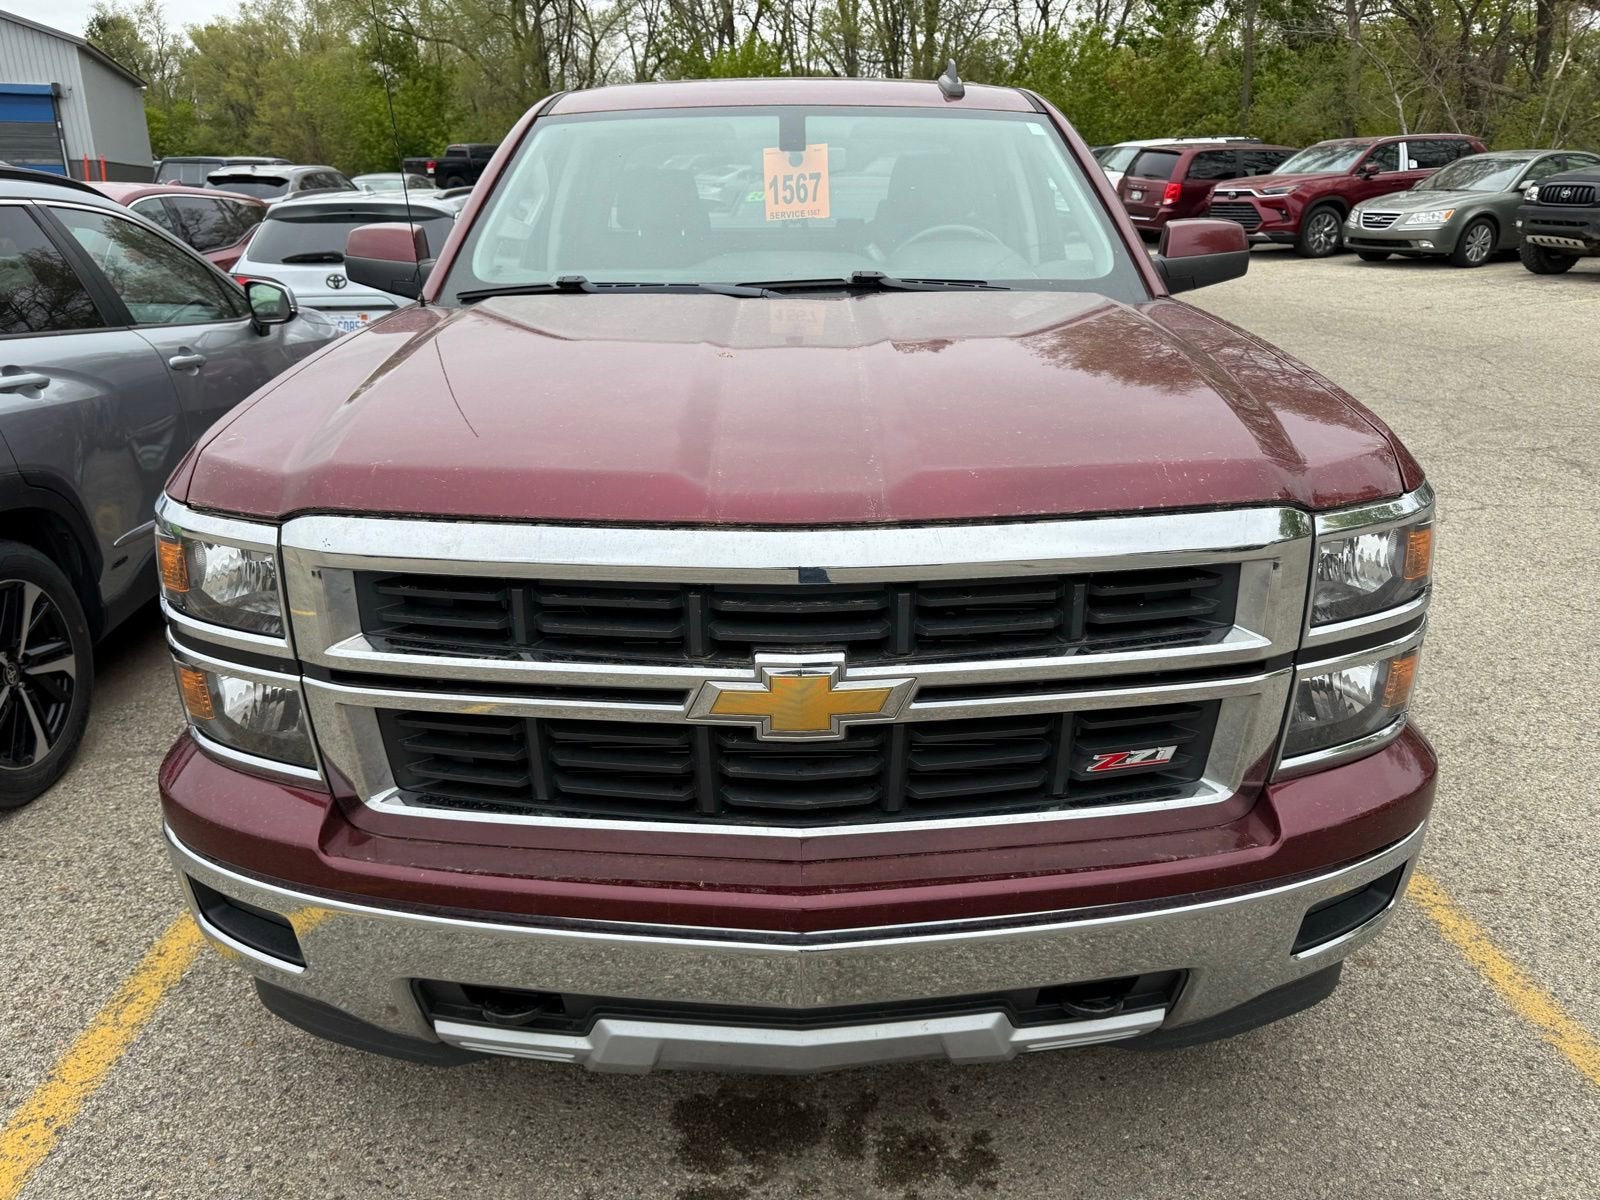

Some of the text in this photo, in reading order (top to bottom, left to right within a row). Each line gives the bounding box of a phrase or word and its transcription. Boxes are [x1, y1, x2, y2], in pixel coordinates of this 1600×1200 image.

[769, 172, 822, 205] 1567
[769, 210, 807, 220] SERVICE
[1086, 745, 1178, 771] Z71
